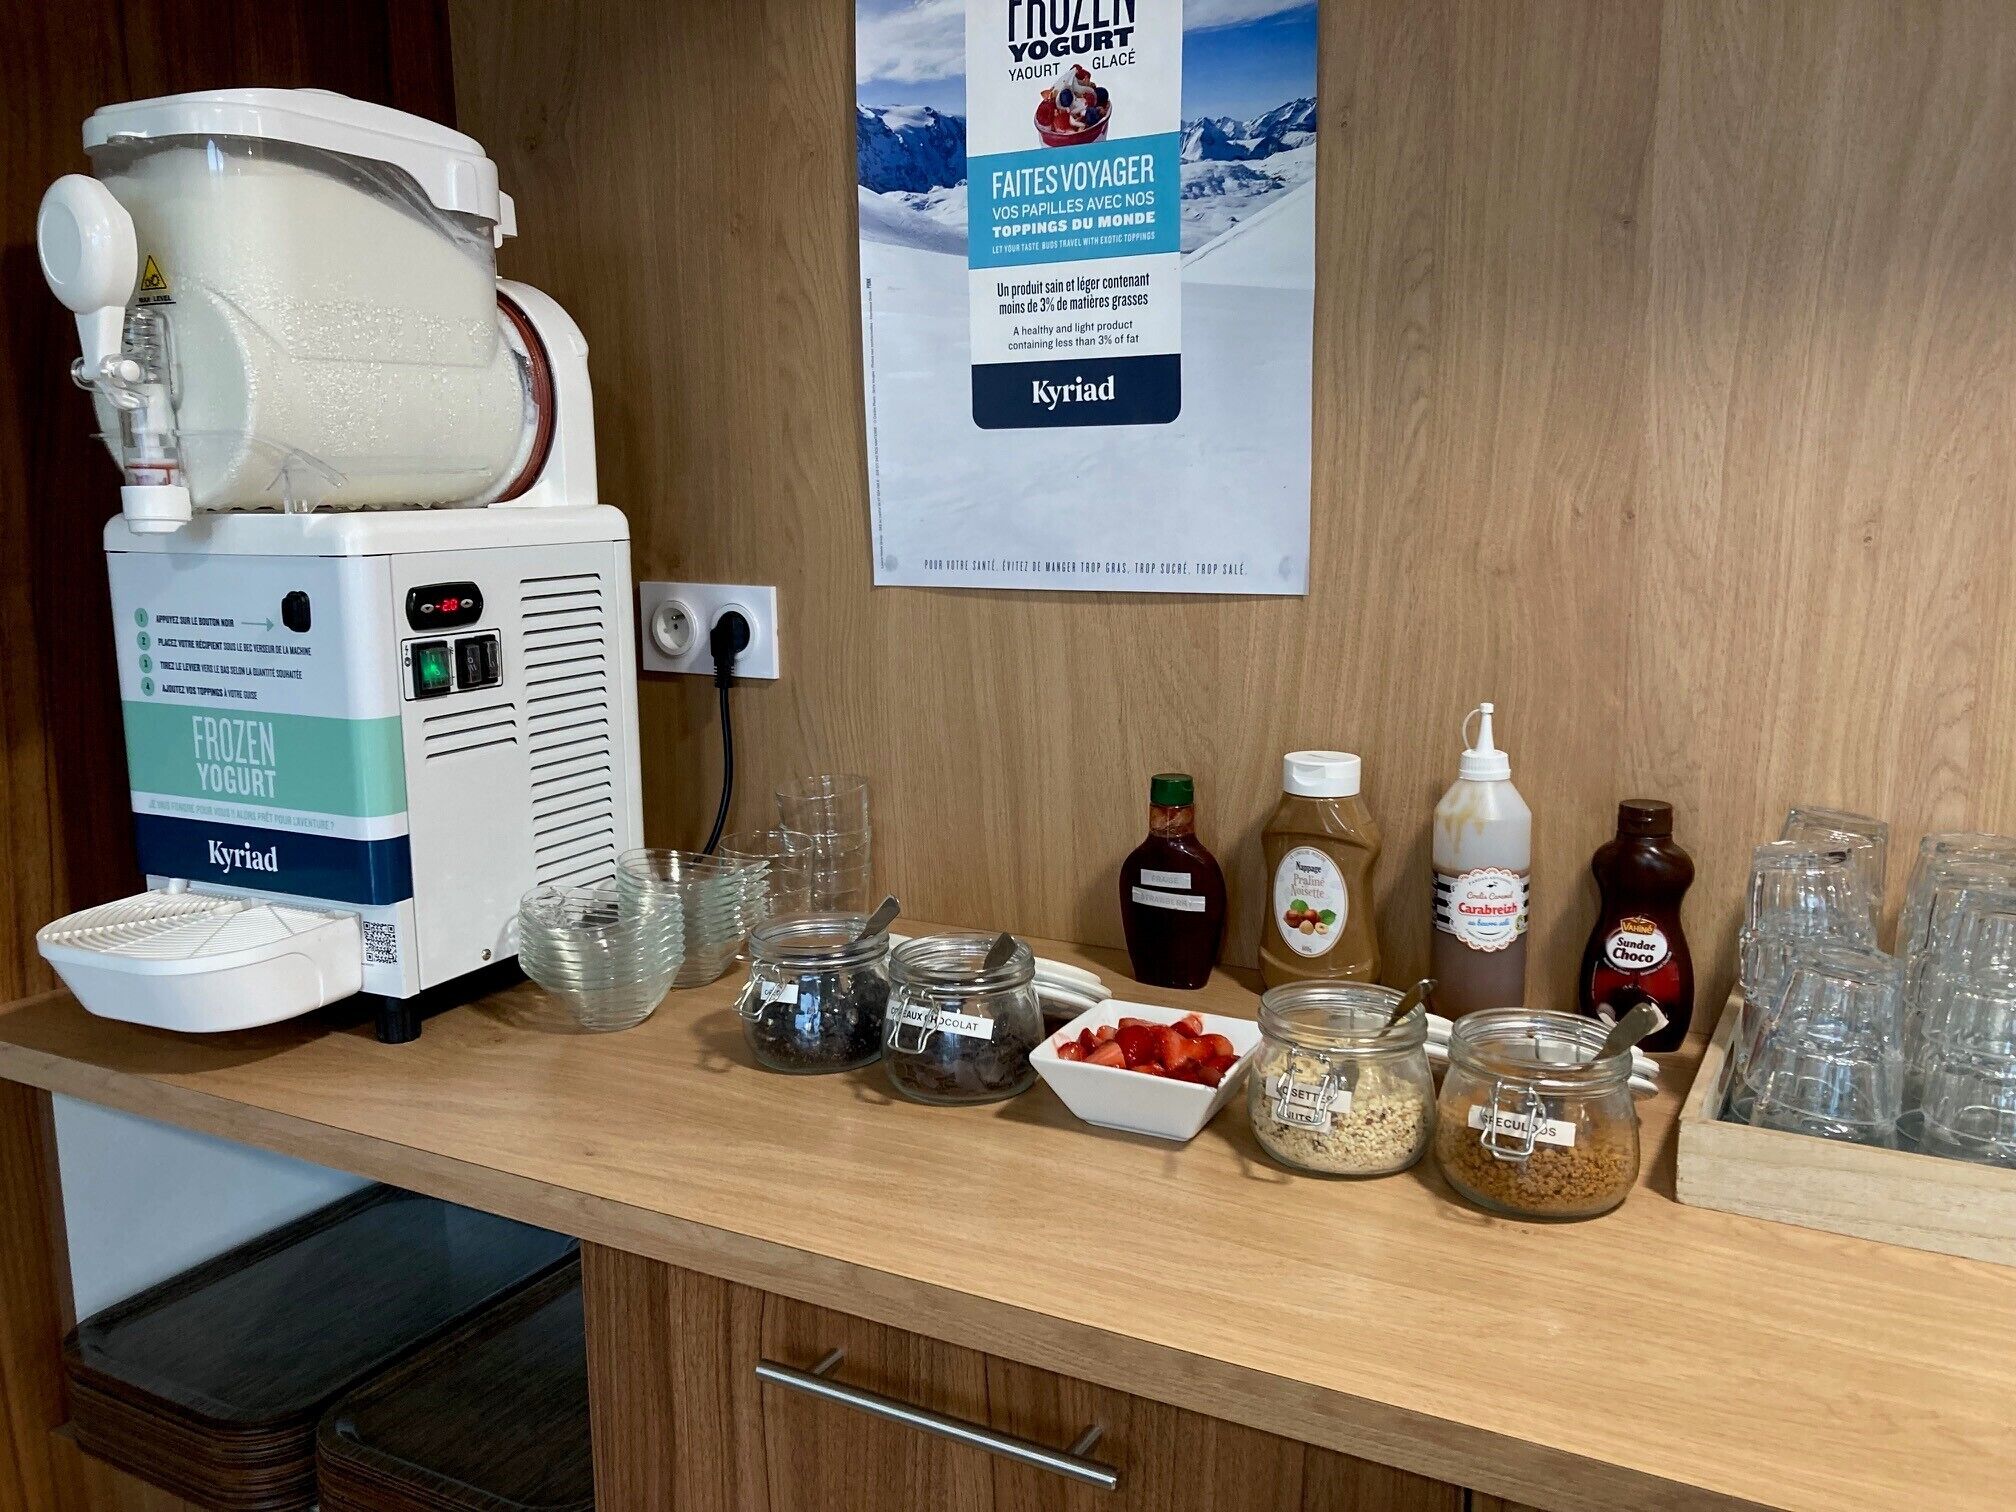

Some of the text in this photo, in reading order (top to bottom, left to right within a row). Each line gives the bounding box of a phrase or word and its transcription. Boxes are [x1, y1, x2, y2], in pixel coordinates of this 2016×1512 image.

[1008, 26, 1134, 63] YOGURT
[1008, 48, 1136, 81] YAOURT GLACÉ
[992, 154, 1154, 199] FAITES VOYAGER
[992, 190, 1154, 220] VOS PAPILLES AVEC NOS
[992, 212, 1155, 238] TOPPINGS DU MONDE
[992, 232, 1156, 254] LET YOUR TASTE BUDS TRAVEL WITH EXOTIC TOPPINGS
[997, 272, 1150, 299] Un produit sain et léger contenant
[999, 293, 1148, 315] moins de 3% de matières grasses
[1013, 320, 1132, 336] A healthy and light product
[1008, 334, 1139, 350] containing less than 3% of fat
[1032, 375, 1116, 411] Kyriad
[924, 559, 943, 570] POUR
[946, 560, 968, 570] VOTRE
[1002, 558, 1028, 572] ÉVITEZ
[1032, 561, 1041, 572] DE
[1045, 562, 1076, 572] MANGER
[1080, 562, 1101, 573] TROP
[1135, 562, 1156, 574] TROP
[1196, 563, 1218, 574] TROP
[156, 614, 178, 624] APPUYEZ
[180, 616, 190, 625] SUR
[192, 616, 198, 626] LE
[198, 617, 220, 626] BOUTON
[220, 618, 234, 628] NOIR
[158, 638, 178, 648] PLACEZ
[178, 639, 194, 648] VOTRE
[196, 639, 222, 650] RÉCIPIENT
[223, 642, 236, 652] SOUS
[237, 643, 242, 652] LE
[243, 644, 252, 652] BEC
[254, 644, 275, 654] VERSEUR
[276, 645, 282, 654] DE
[282, 646, 289, 654] LA
[290, 646, 312, 656] MACHINE
[160, 660, 174, 670] TIREZ
[175, 662, 182, 670] LE
[182, 662, 200, 672] LEVIER
[201, 664, 213, 673] VERS
[214, 665, 220, 674] LE
[220, 666, 229, 674] BAS
[230, 666, 245, 676] SELON
[246, 668, 252, 676] LA
[162, 684, 184, 693] AJOUTEZ
[186, 686, 196, 694] VOS
[197, 686, 223, 697] TOPPINGS
[228, 690, 242, 698] VOTRE
[192, 716, 276, 766] FROZEN
[196, 762, 276, 798] YOGURT
[208, 839, 278, 874] Kyriad
[1296, 860, 1322, 874] Nappage
[1294, 873, 1326, 886] Praliné
[1290, 884, 1325, 898] Noisette
[1458, 902, 1518, 915] Carabreizh
[1616, 936, 1656, 951] Sundae
[1612, 947, 1654, 963] Choco
[890, 1006, 923, 1022] COEAUX
[1279, 1086, 1333, 1104] OSETTES
